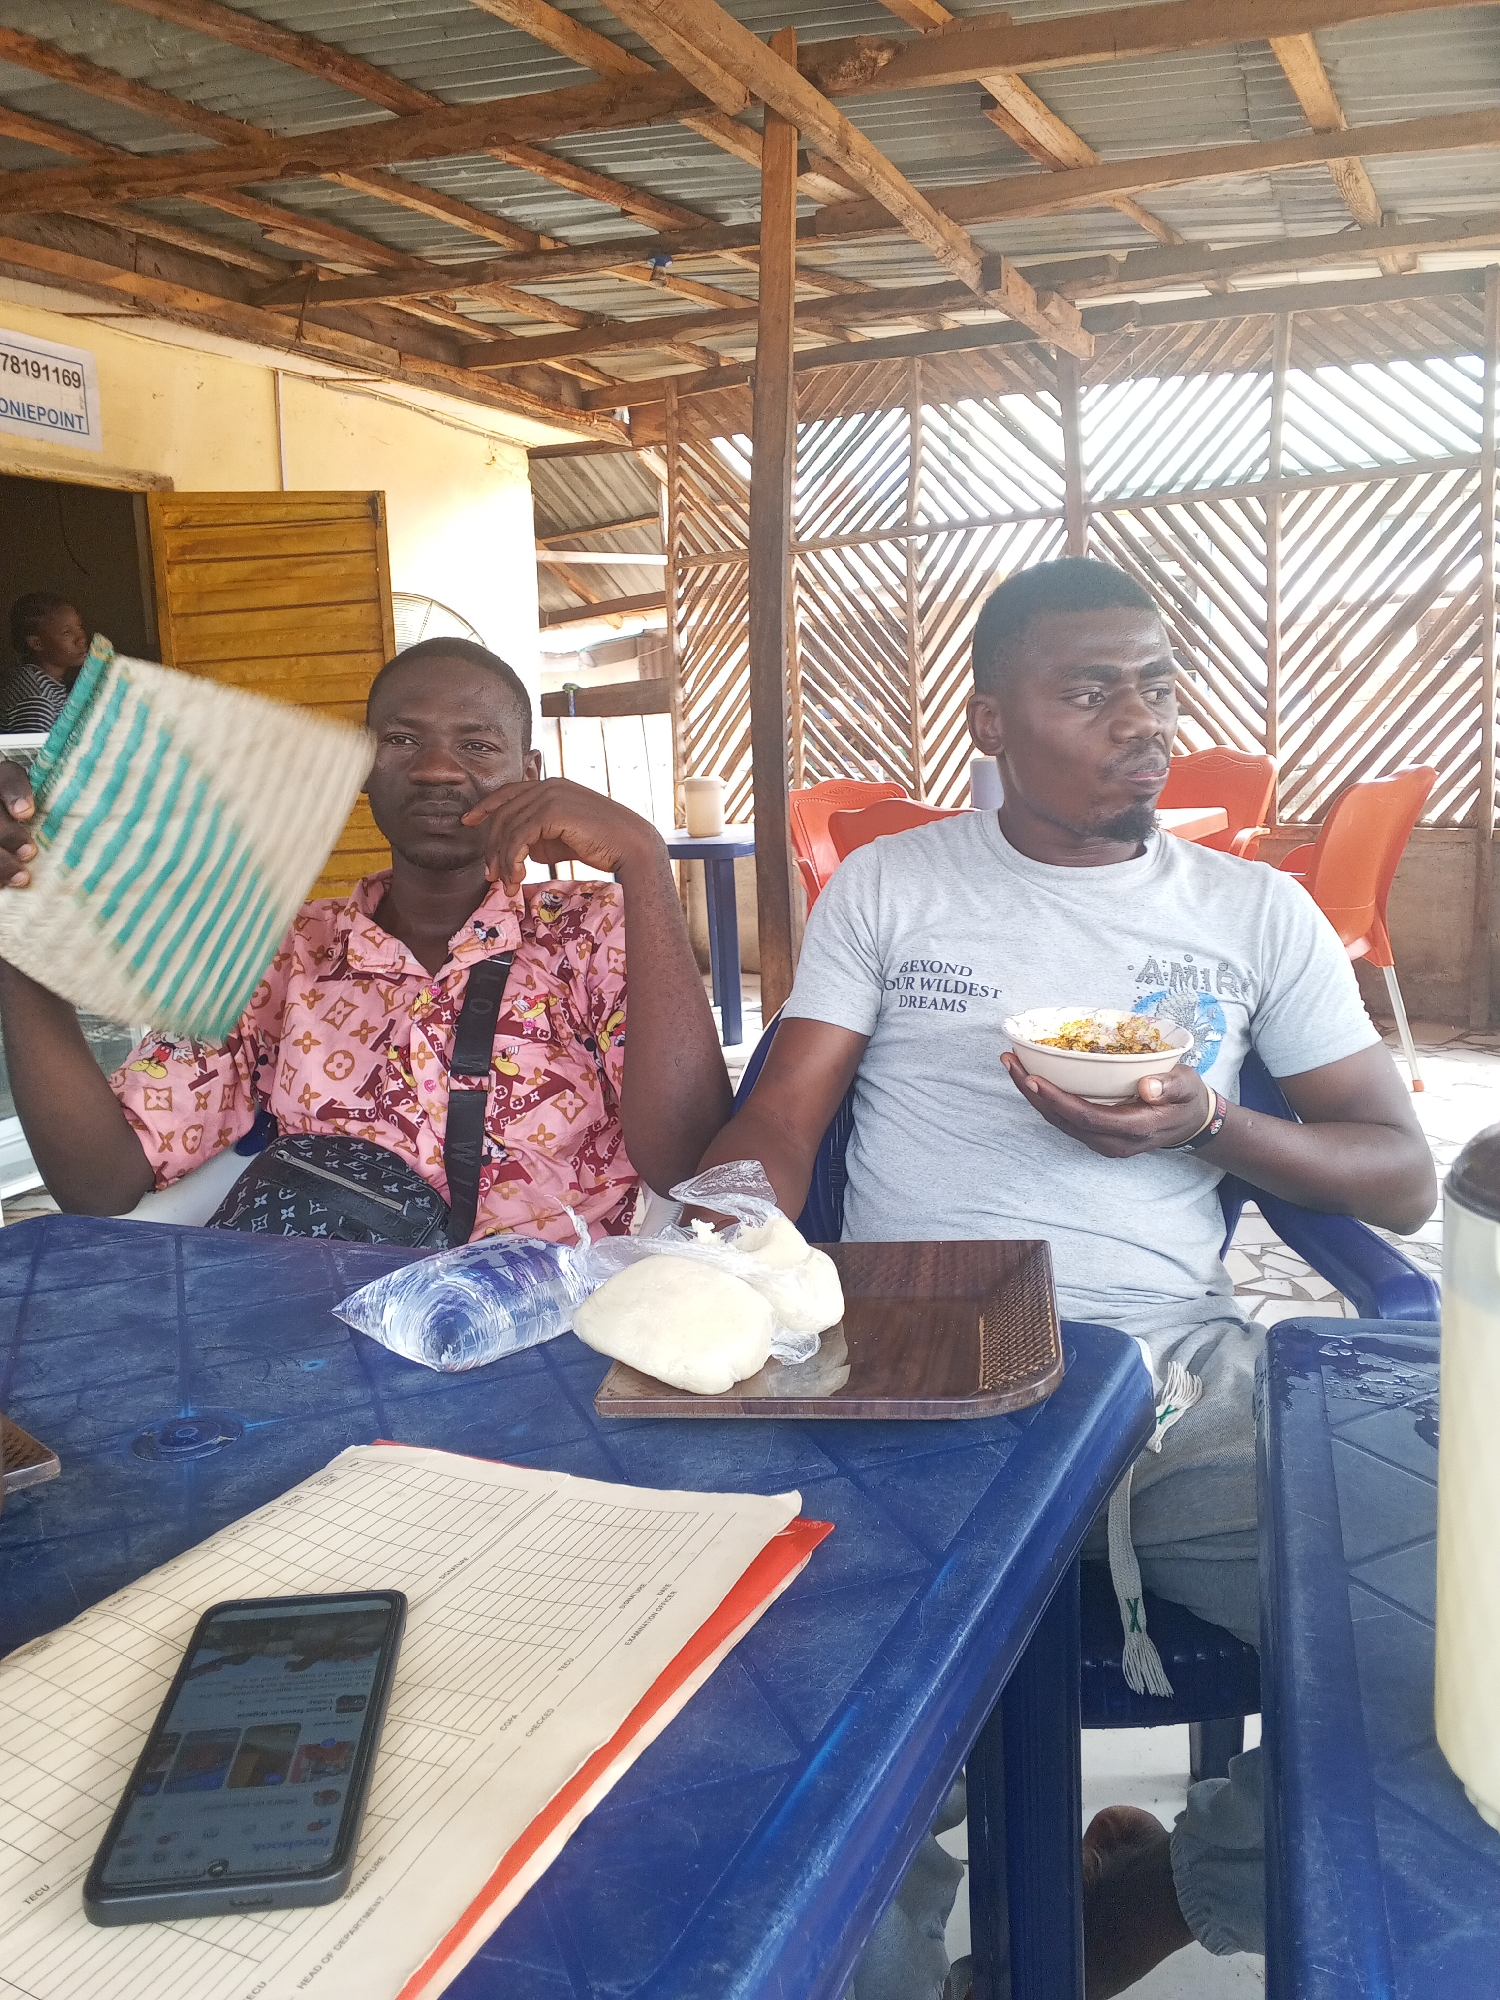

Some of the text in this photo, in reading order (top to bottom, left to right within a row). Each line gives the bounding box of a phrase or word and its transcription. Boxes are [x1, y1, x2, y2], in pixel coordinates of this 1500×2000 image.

[0, 352, 82, 389] 78191169
[0, 397, 85, 431] ONIEPOINT
[899, 960, 973, 977] BEYOND
[884, 976, 1003, 999] OUR WILDEST
[898, 994, 968, 1013] DREAMS
[618, 1583, 648, 1610] SIGNATURE
[624, 1590, 678, 1646] EXAMINATION OFFICER
[557, 1657, 575, 1672] TECU
[525, 1707, 555, 1738] CHECKED
[252, 1836, 331, 1852] facebook
[343, 1855, 387, 1900] SIGNATURE
[22, 1884, 50, 1905] TECU
[296, 1895, 385, 1990] HEAD OF DEPARTMENT
[243, 1981, 267, 2000] ECU
